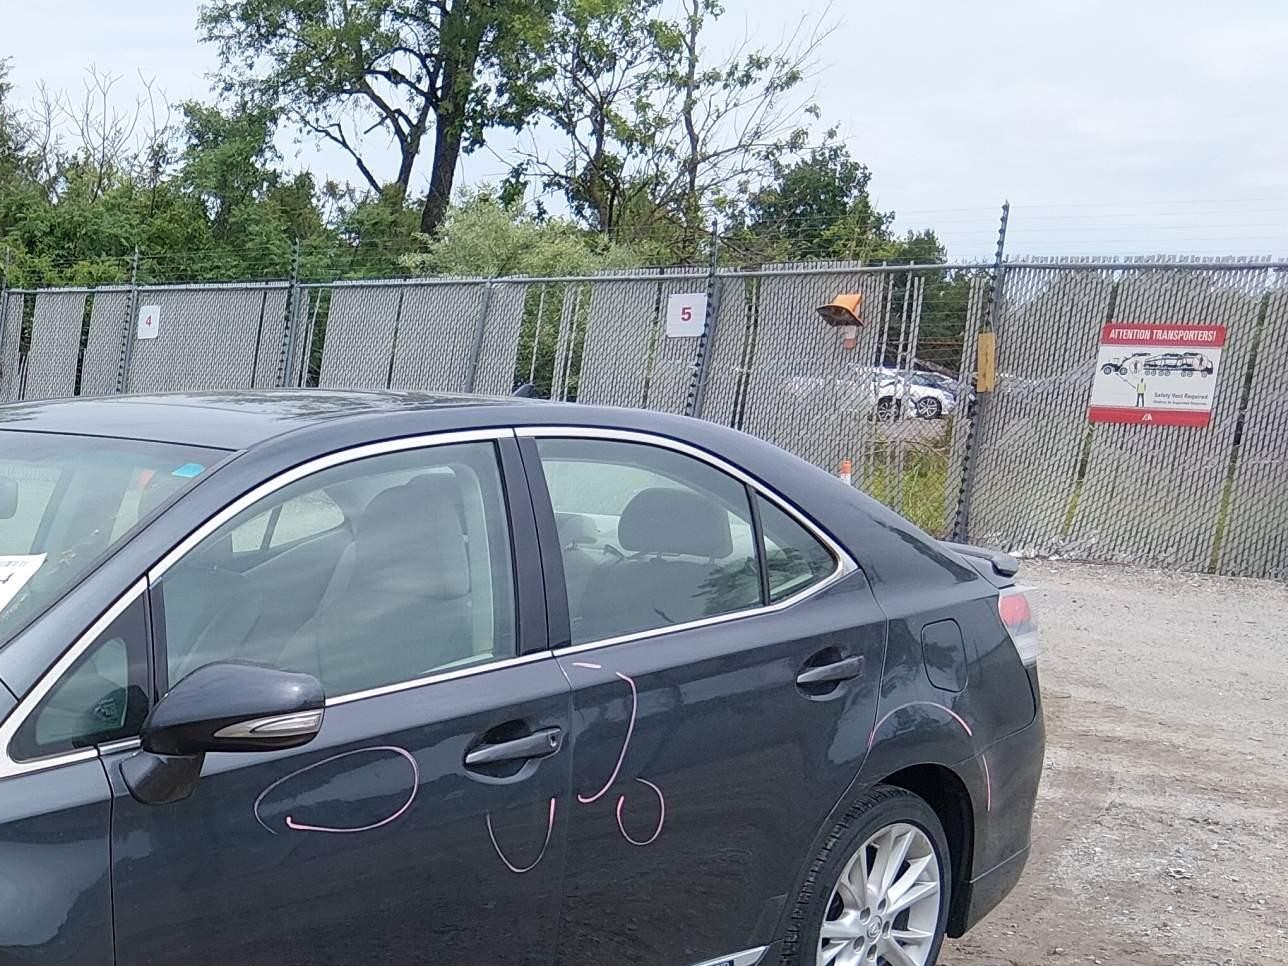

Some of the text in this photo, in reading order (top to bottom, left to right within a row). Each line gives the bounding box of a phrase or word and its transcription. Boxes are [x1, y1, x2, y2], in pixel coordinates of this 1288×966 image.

[680, 306, 693, 322] 5
[145, 315, 153, 328] 4
[1109, 328, 1217, 342] ATTENTION TRANSPORTERS!
